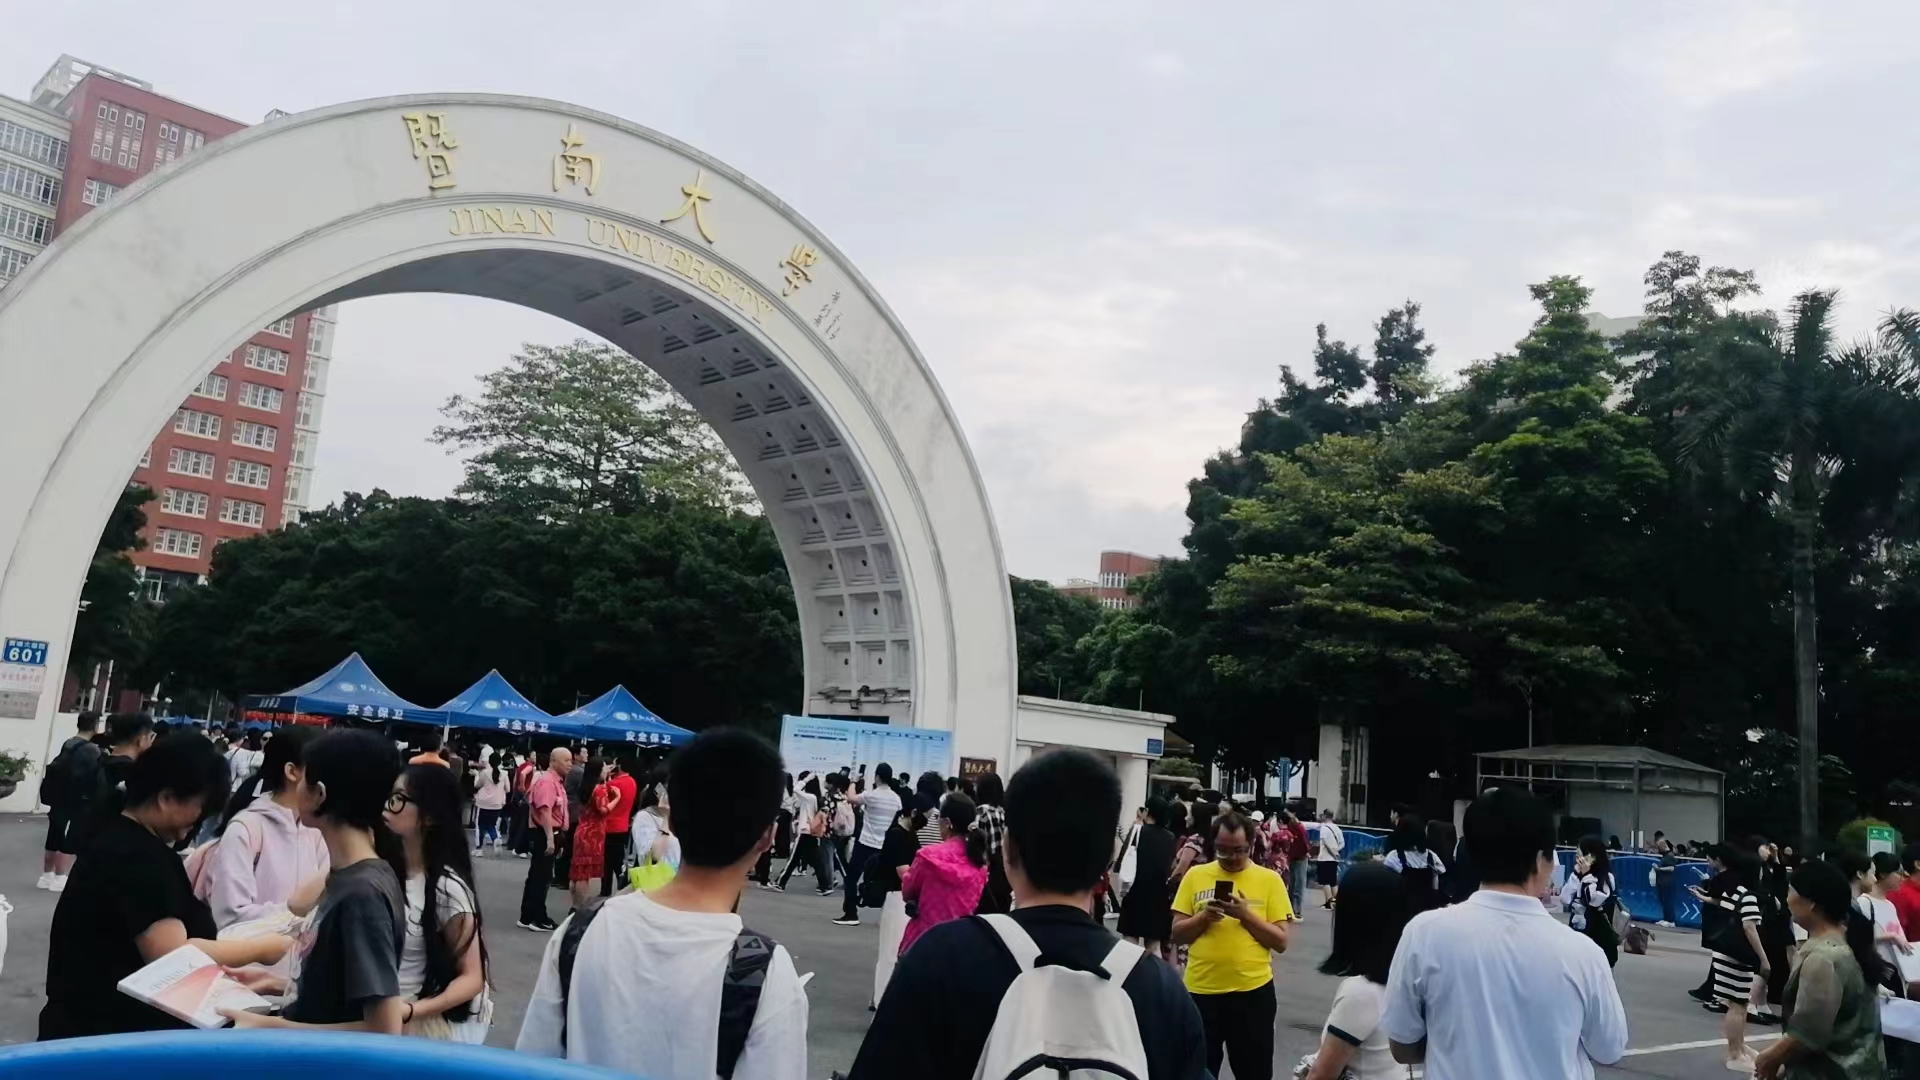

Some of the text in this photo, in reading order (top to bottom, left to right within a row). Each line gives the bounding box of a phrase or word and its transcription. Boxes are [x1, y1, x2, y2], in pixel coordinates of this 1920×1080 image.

[449, 208, 556, 236] JINAN
[585, 217, 776, 325] UNIVERSITY
[9, 647, 42, 663] 601
[346, 703, 404, 720] 安全保卫
[497, 718, 550, 734] 安全保卫
[625, 730, 672, 745] 安全保卫
